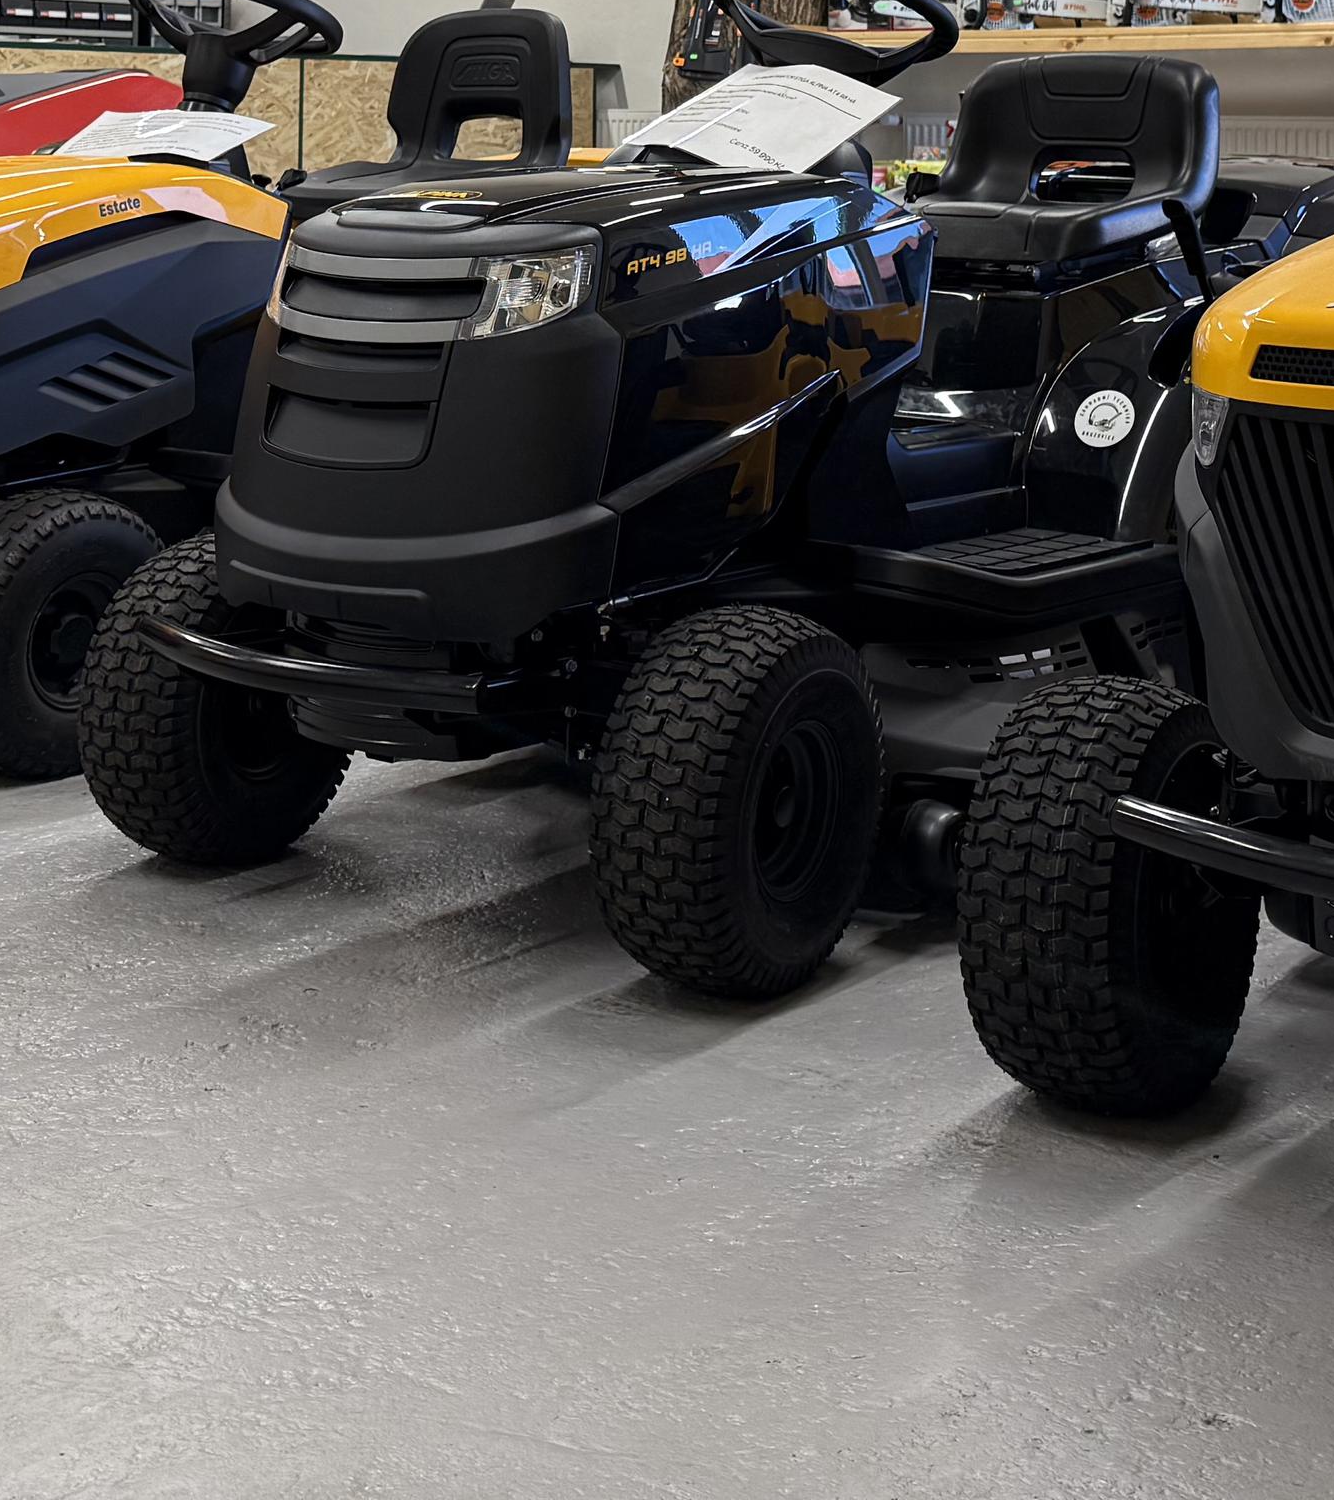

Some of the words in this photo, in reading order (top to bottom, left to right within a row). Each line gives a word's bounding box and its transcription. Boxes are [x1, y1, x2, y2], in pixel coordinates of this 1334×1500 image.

[99, 196, 141, 217] Estate
[627, 253, 661, 276] AT4
[692, 241, 713, 257] HA
